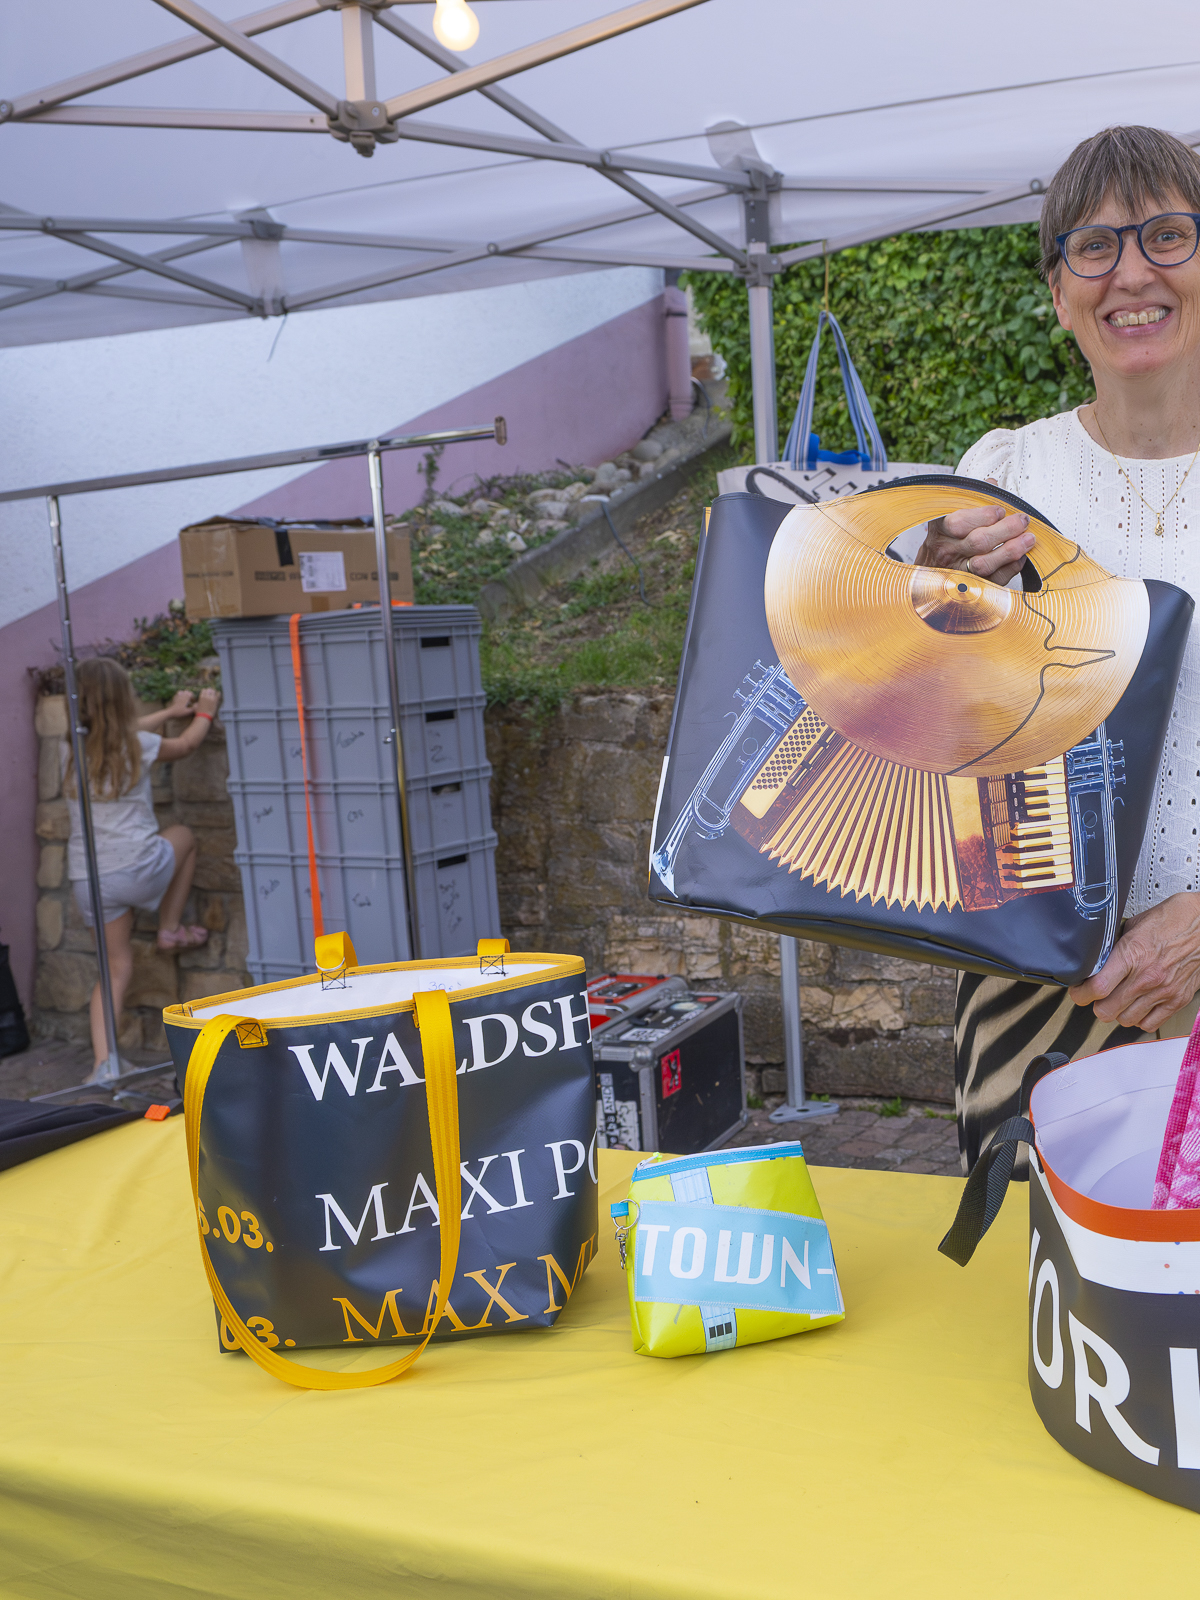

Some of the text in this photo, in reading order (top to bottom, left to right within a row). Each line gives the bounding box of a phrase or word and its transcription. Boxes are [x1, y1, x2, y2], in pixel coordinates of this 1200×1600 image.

[287, 990, 593, 1101] WADSH
[315, 1127, 599, 1252] MAXI P
[332, 1262, 530, 1342] MAX
[638, 1223, 833, 1291] TOWN-
